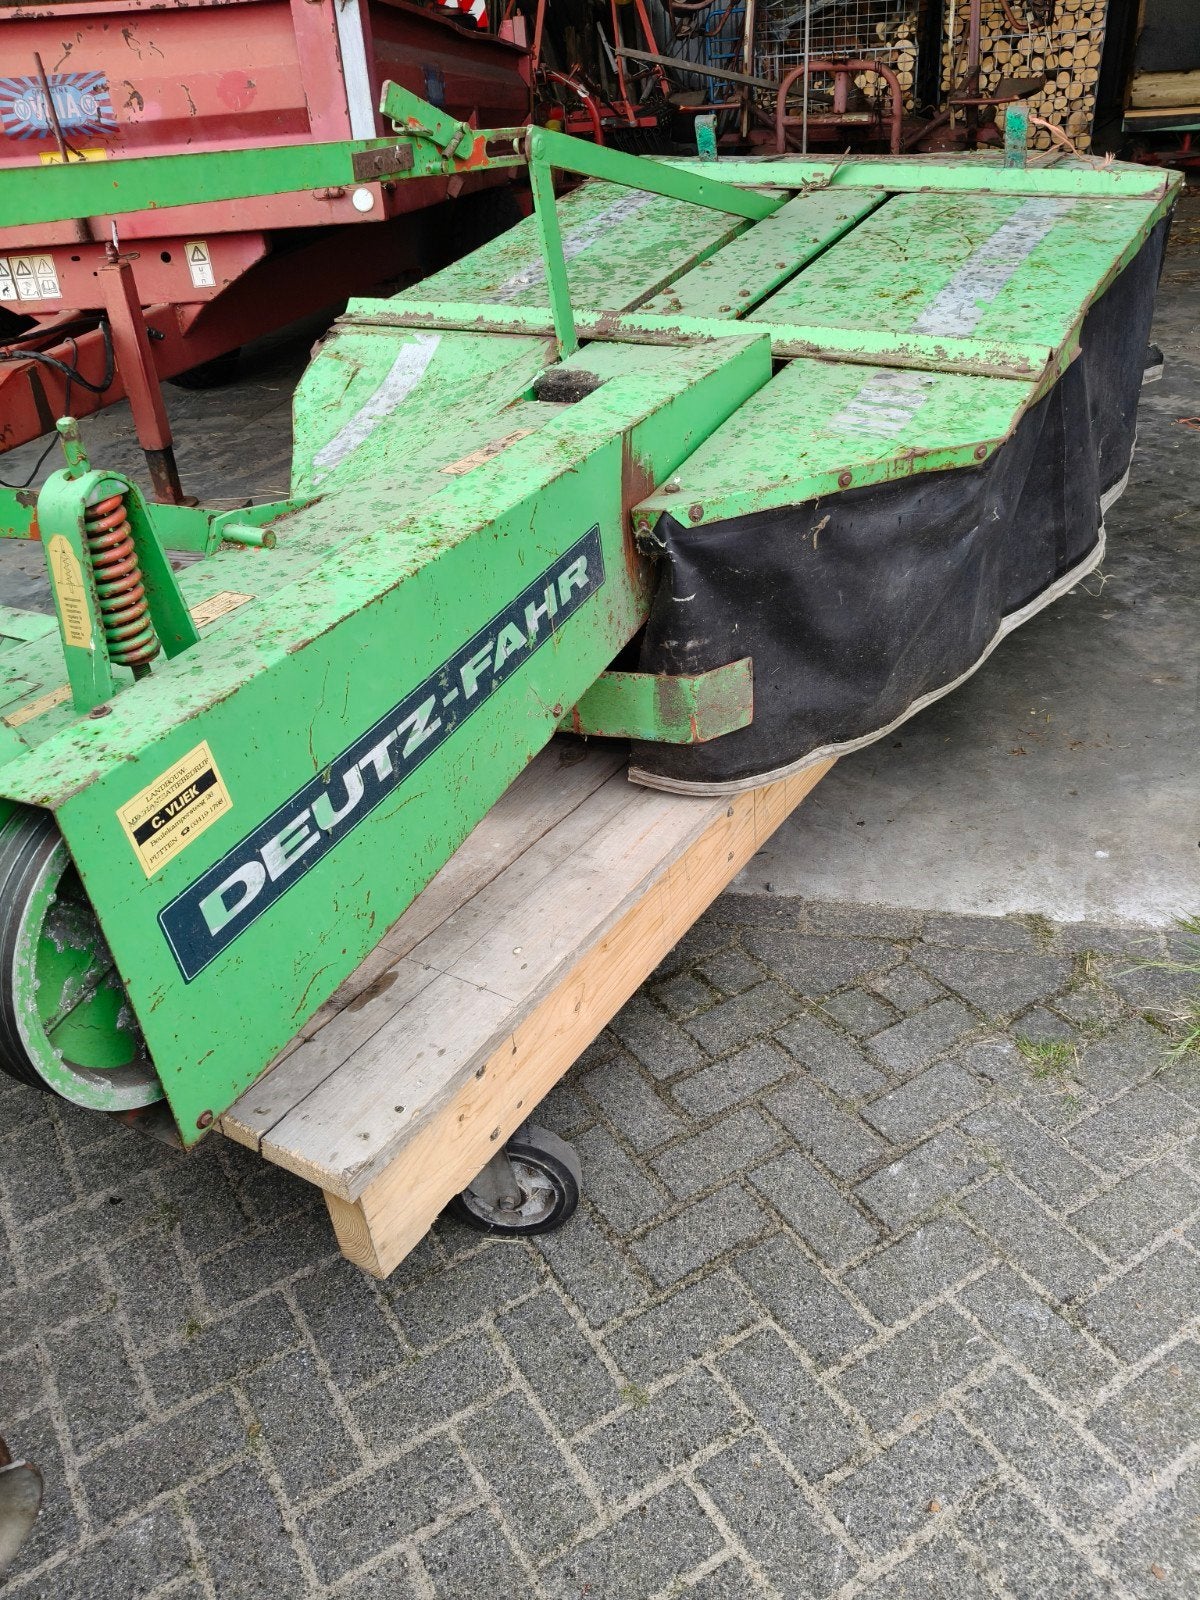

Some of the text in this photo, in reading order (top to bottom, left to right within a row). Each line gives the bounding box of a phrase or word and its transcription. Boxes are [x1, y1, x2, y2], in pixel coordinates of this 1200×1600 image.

[199, 555, 589, 937] DEUTZ-FAHR
[151, 783, 200, 830] C. VLIEK
[149, 836, 179, 864] PUTTEN
